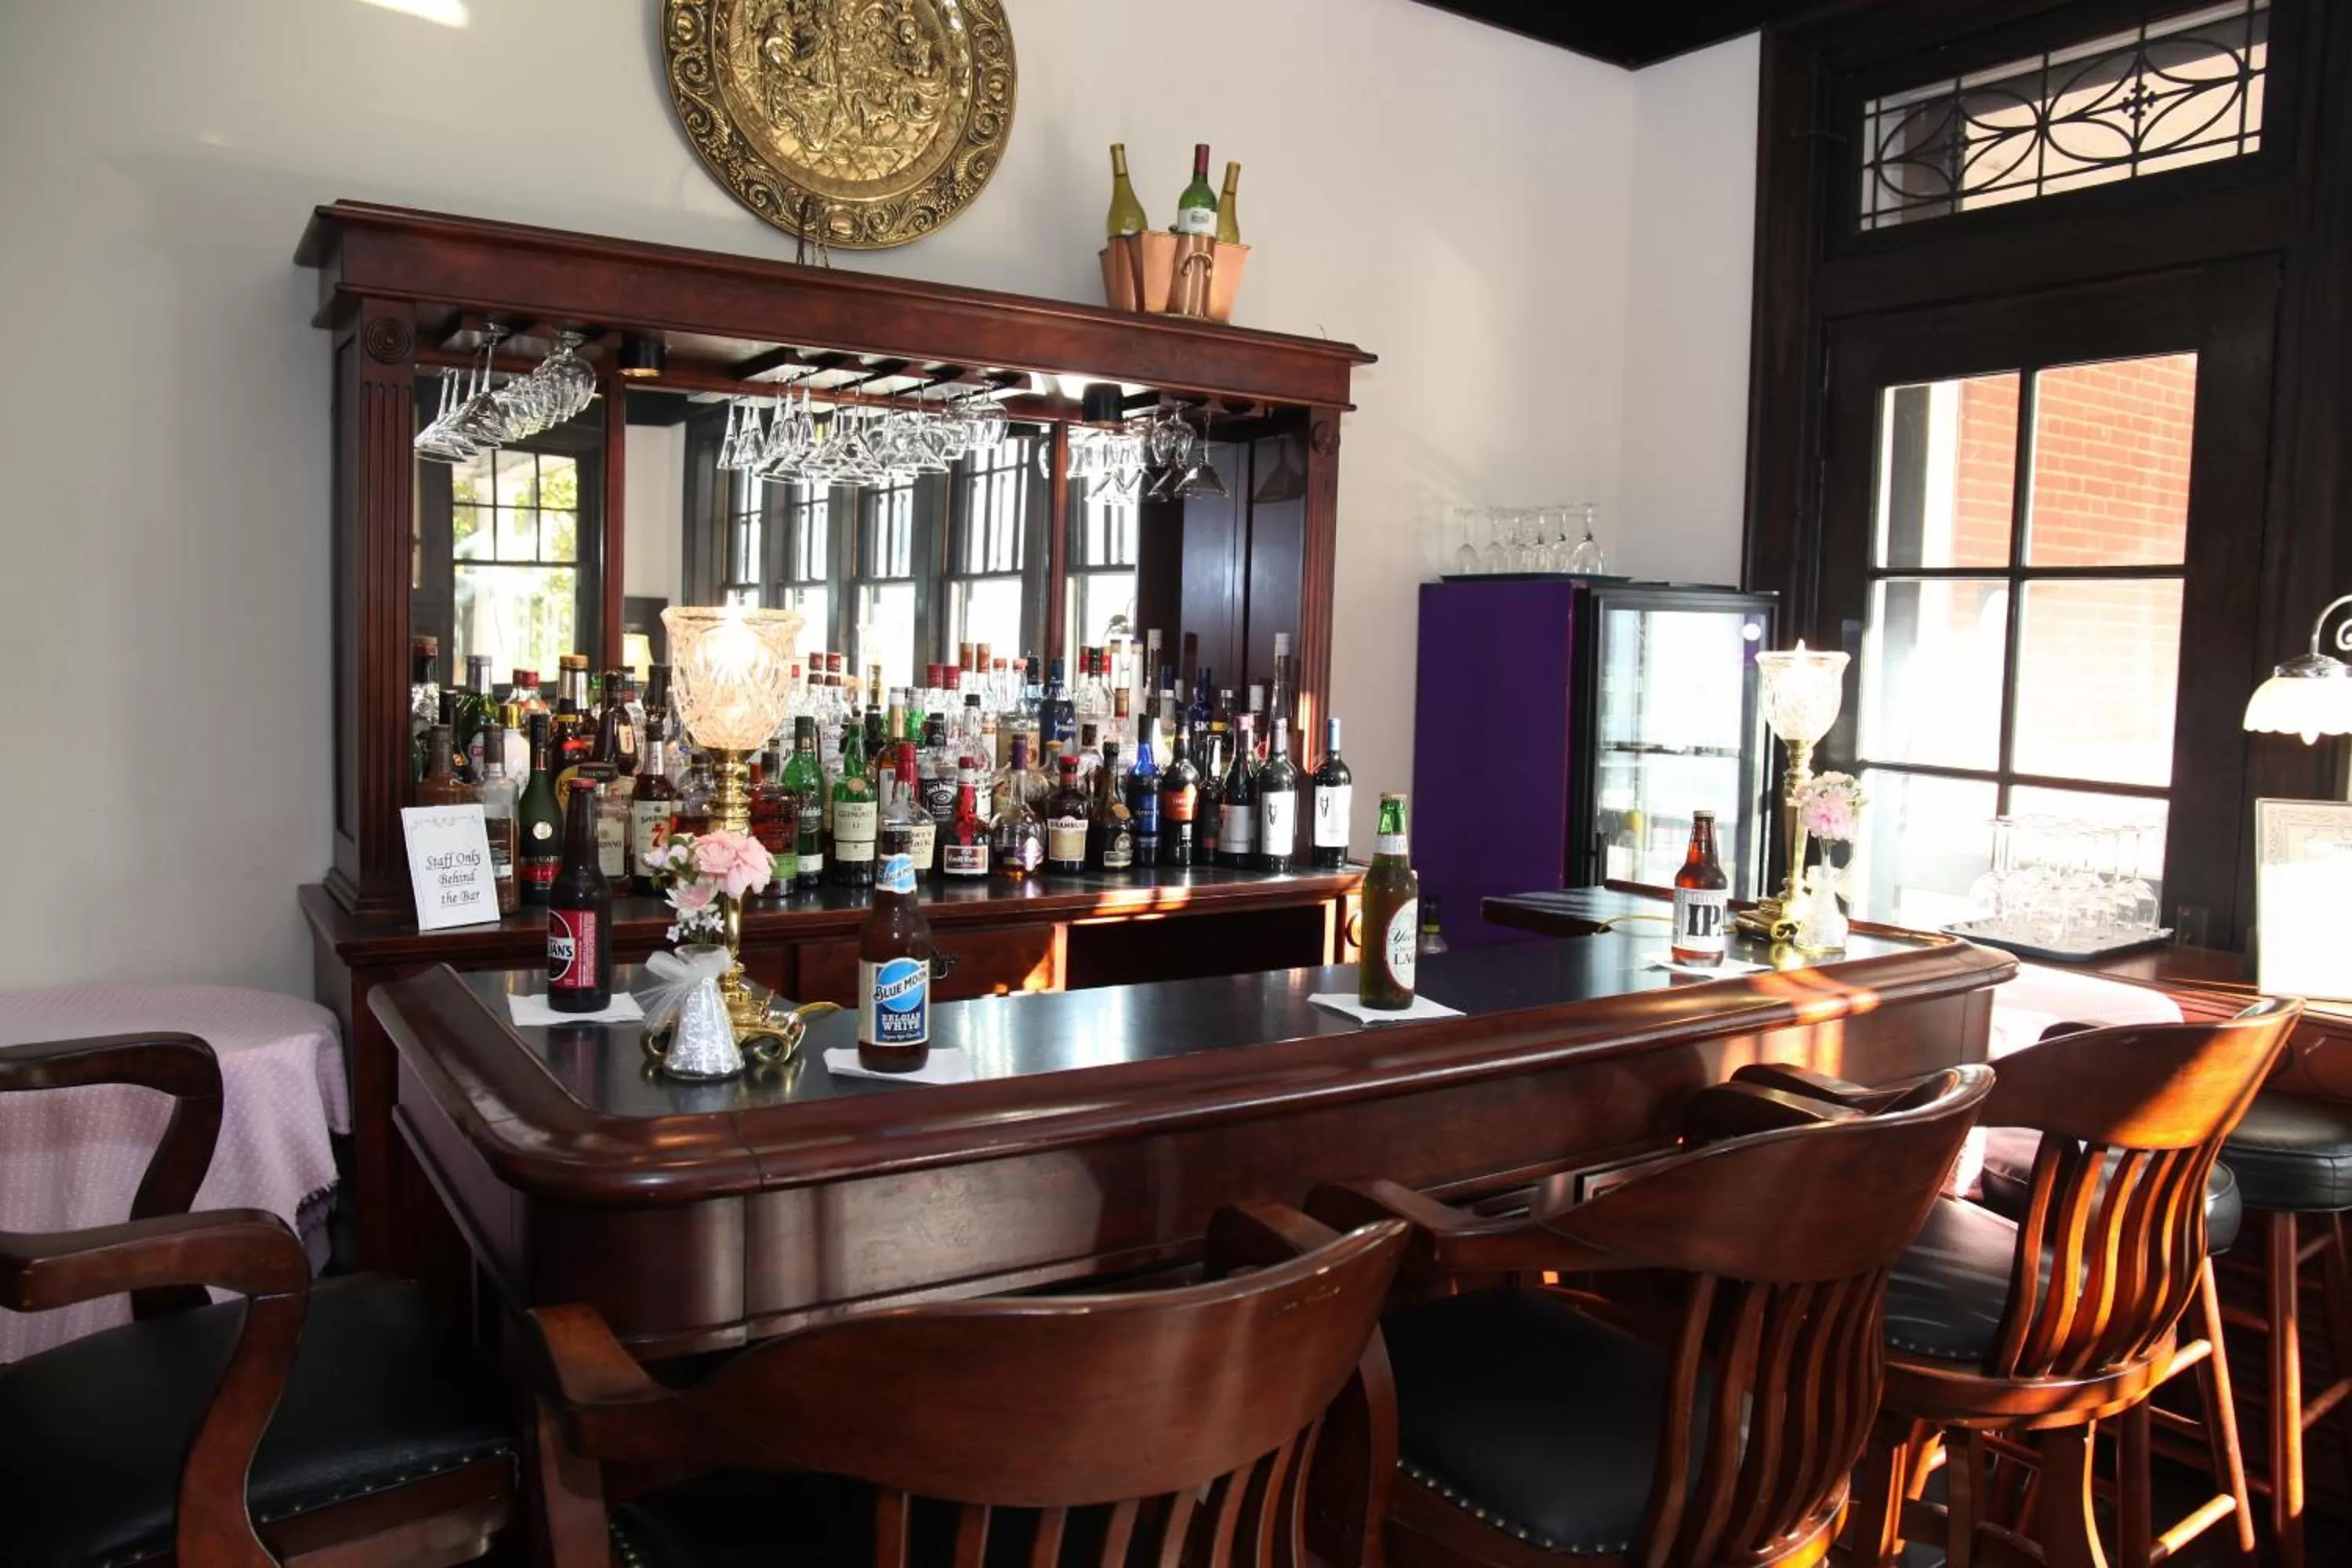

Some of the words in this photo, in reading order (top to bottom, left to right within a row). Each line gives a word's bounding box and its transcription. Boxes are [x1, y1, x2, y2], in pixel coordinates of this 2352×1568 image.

[426, 851, 455, 870] Staff
[456, 849, 481, 866] Only
[439, 868, 477, 885] Behind
[441, 891, 458, 904] the
[460, 890, 480, 902] Bar
[873, 983, 902, 1001] BLUE
[882, 1021, 921, 1032] WHITE
